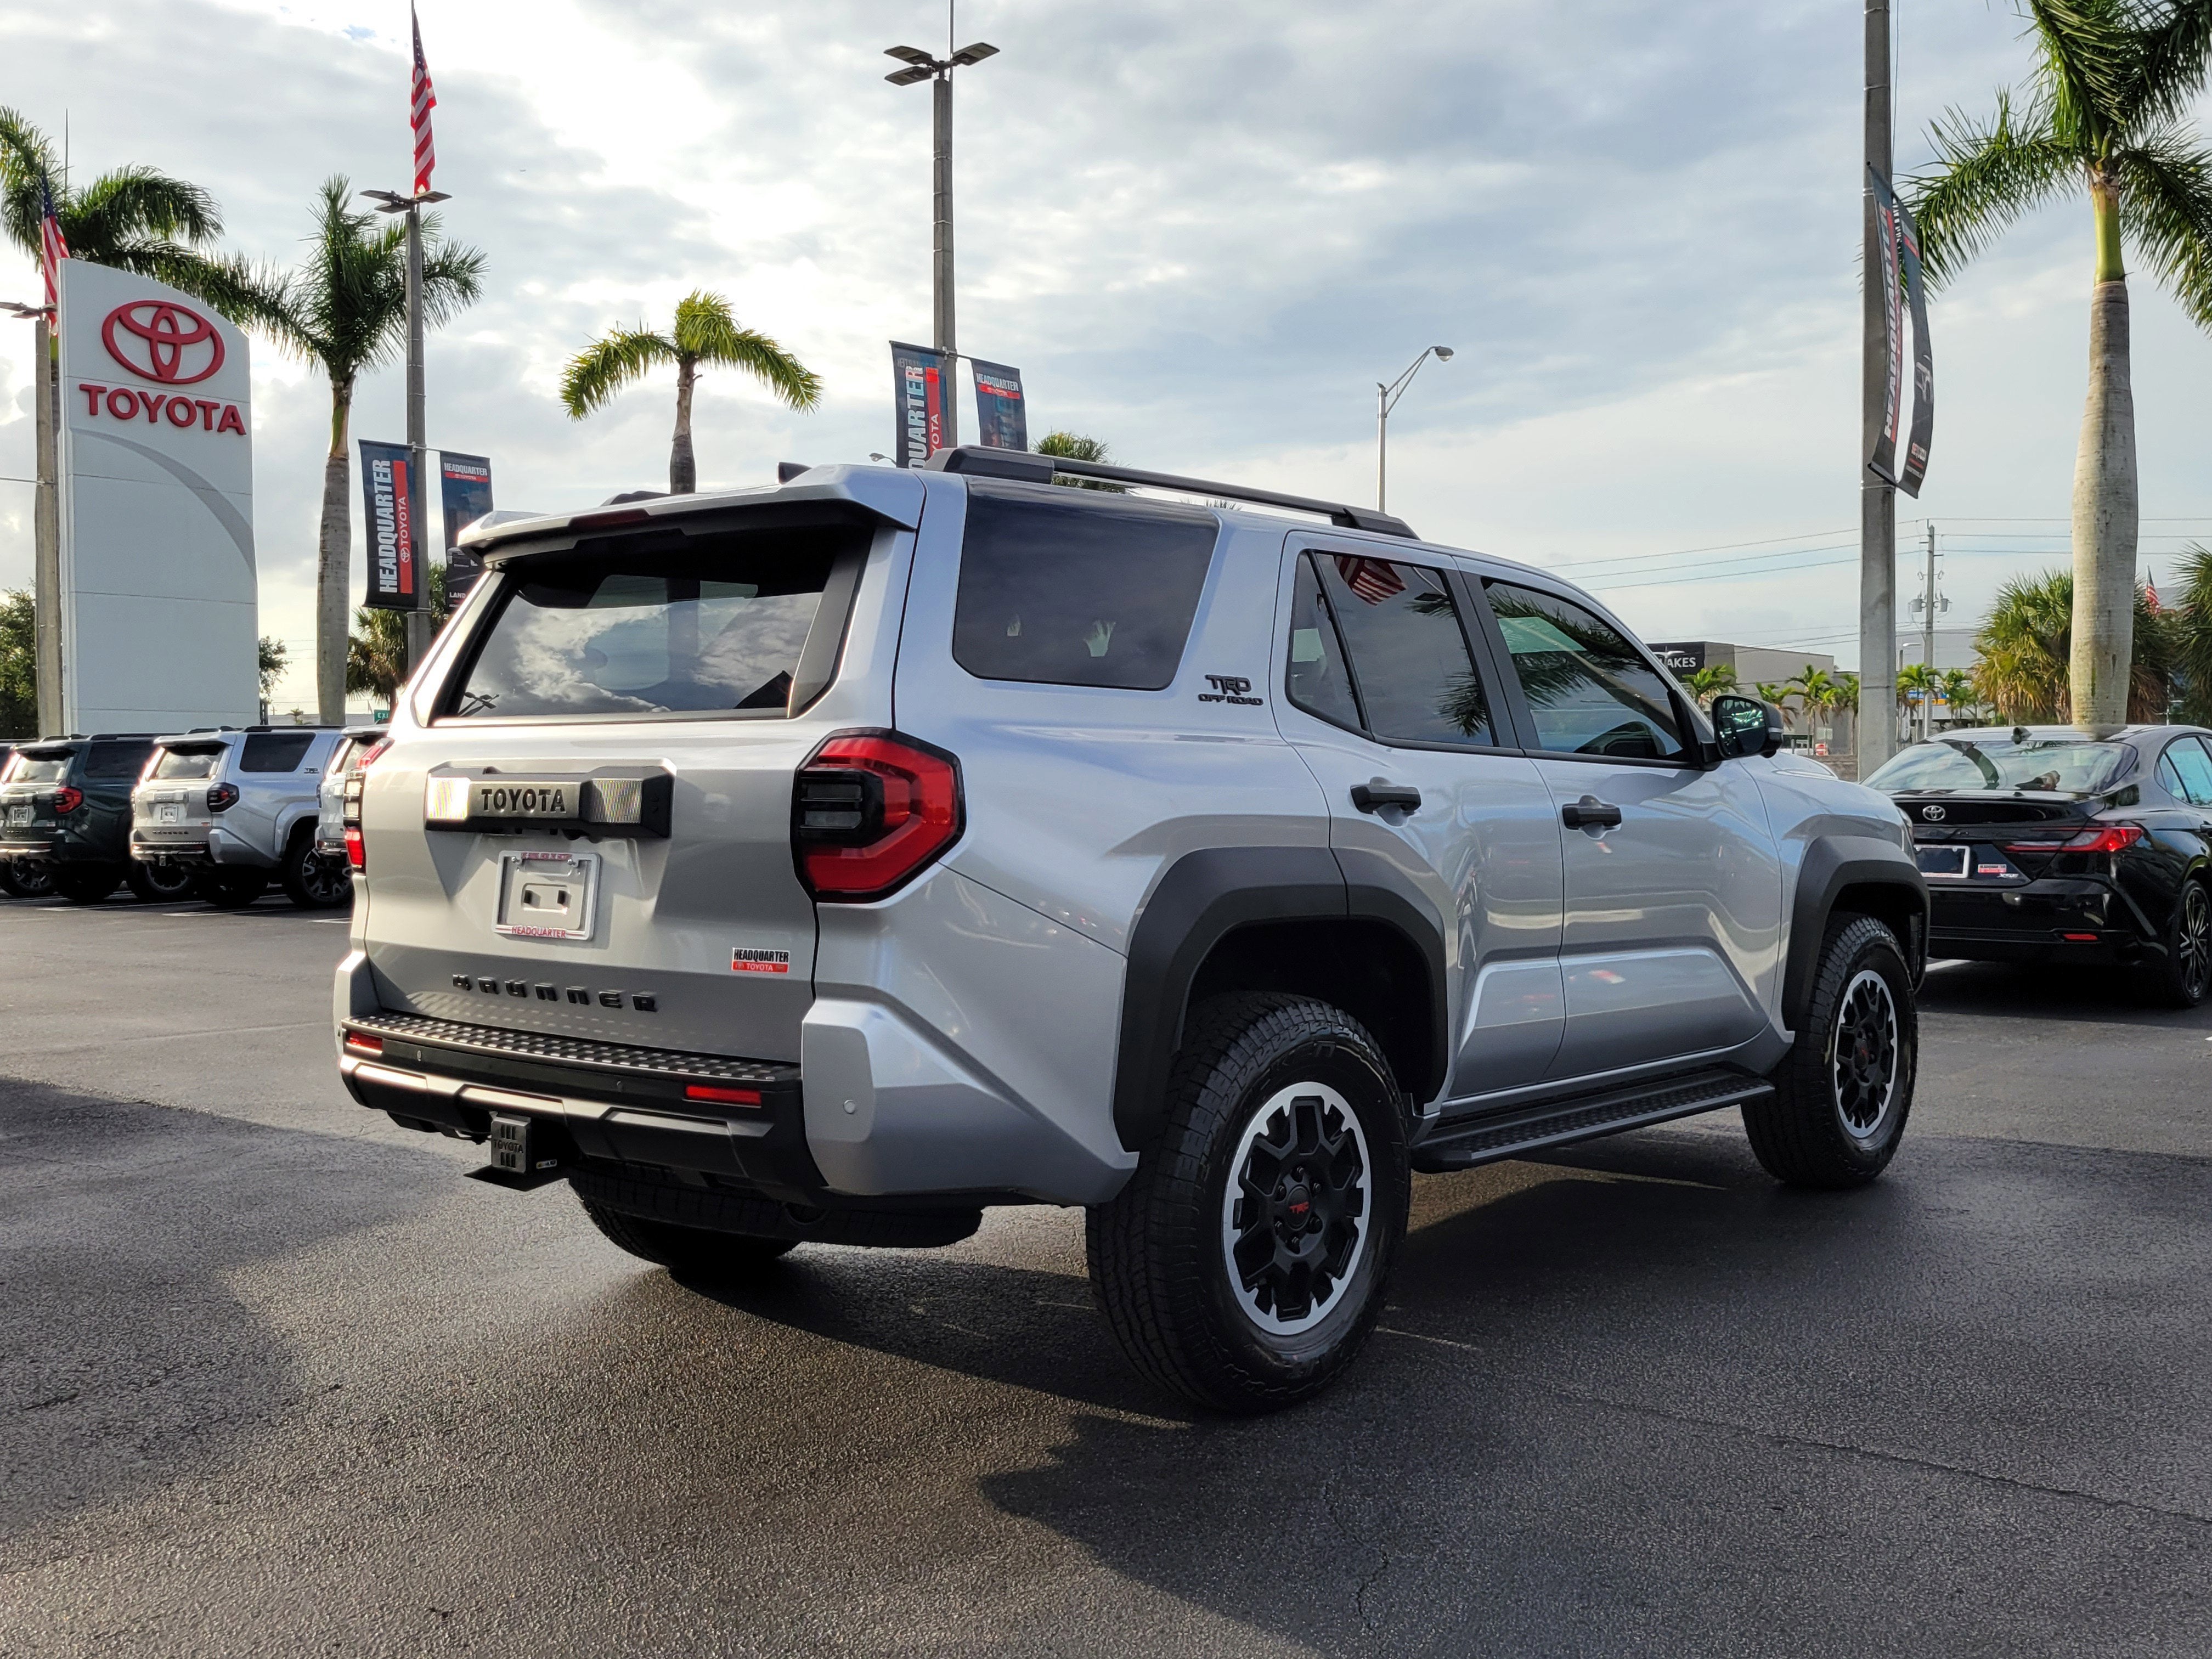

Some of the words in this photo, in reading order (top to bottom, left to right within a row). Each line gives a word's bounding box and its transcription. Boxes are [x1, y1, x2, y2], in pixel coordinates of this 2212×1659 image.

[976, 372, 1019, 392] HEADQUARTER
[79, 383, 247, 436] TOYOTA
[443, 462, 488, 476] HEADQUARTER
[372, 459, 398, 593] HEADQUARTER
[397, 496, 410, 545] TOYOTA
[1658, 657, 1696, 668] AKES
[1205, 674, 1251, 696] TRD
[1198, 693, 1226, 703] OFF
[1226, 695, 1264, 706] ROAD
[481, 788, 567, 814] TOYOTA
[511, 926, 567, 938] HEADQUARTER
[733, 949, 789, 963] HEADQUARTER
[747, 963, 774, 972] TOYOTA
[452, 973, 658, 1013] 4RUNNER
[494, 1139, 524, 1154] TOYOTA
